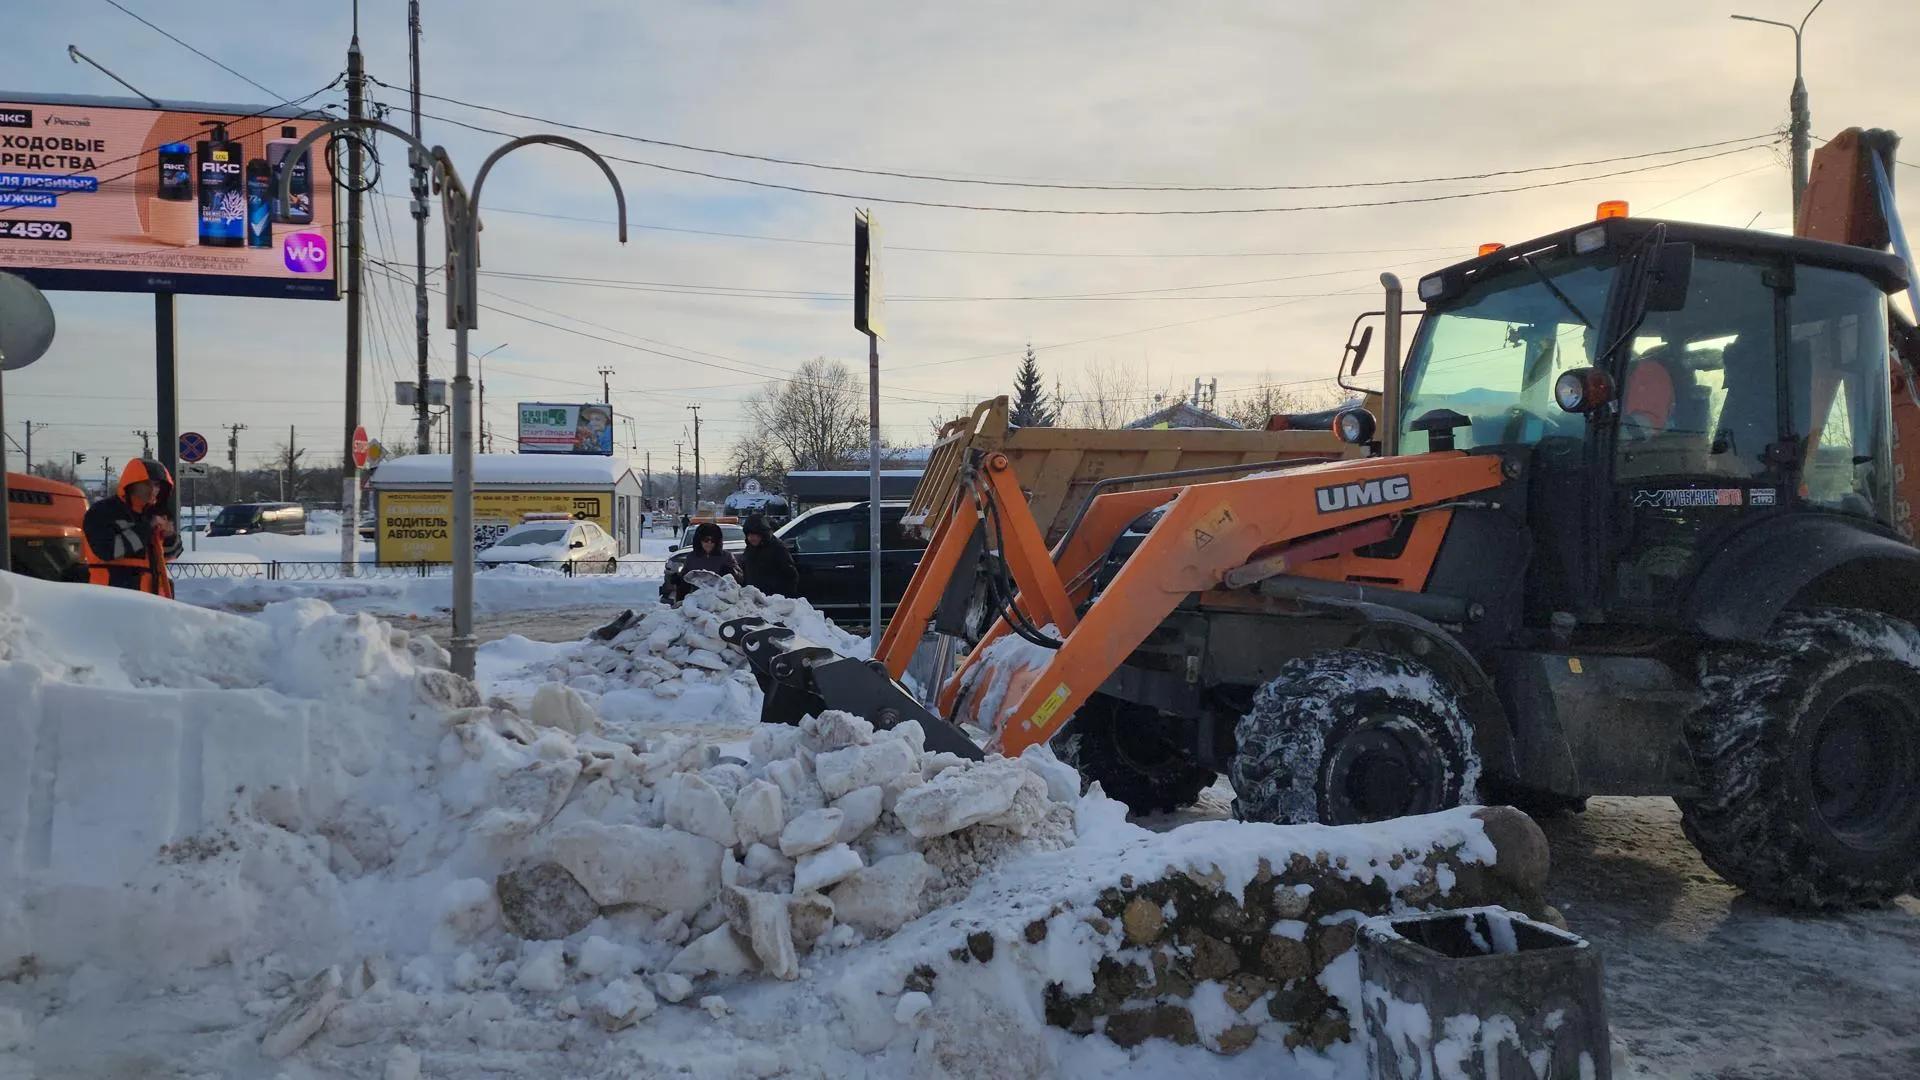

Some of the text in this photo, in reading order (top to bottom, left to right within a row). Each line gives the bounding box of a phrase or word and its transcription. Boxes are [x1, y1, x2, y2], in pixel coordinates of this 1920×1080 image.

[2, 135, 105, 152] ХОДОВЫЕ
[2, 153, 96, 170] РЕДСТВА
[202, 162, 240, 173] АКС
[0, 193, 52, 204] УЖЧИН
[286, 241, 325, 262] wb
[1317, 476, 1409, 511] UMG
[387, 517, 447, 528] ВОДИТЕЛЬ
[387, 529, 448, 539] АВТОБУСА
